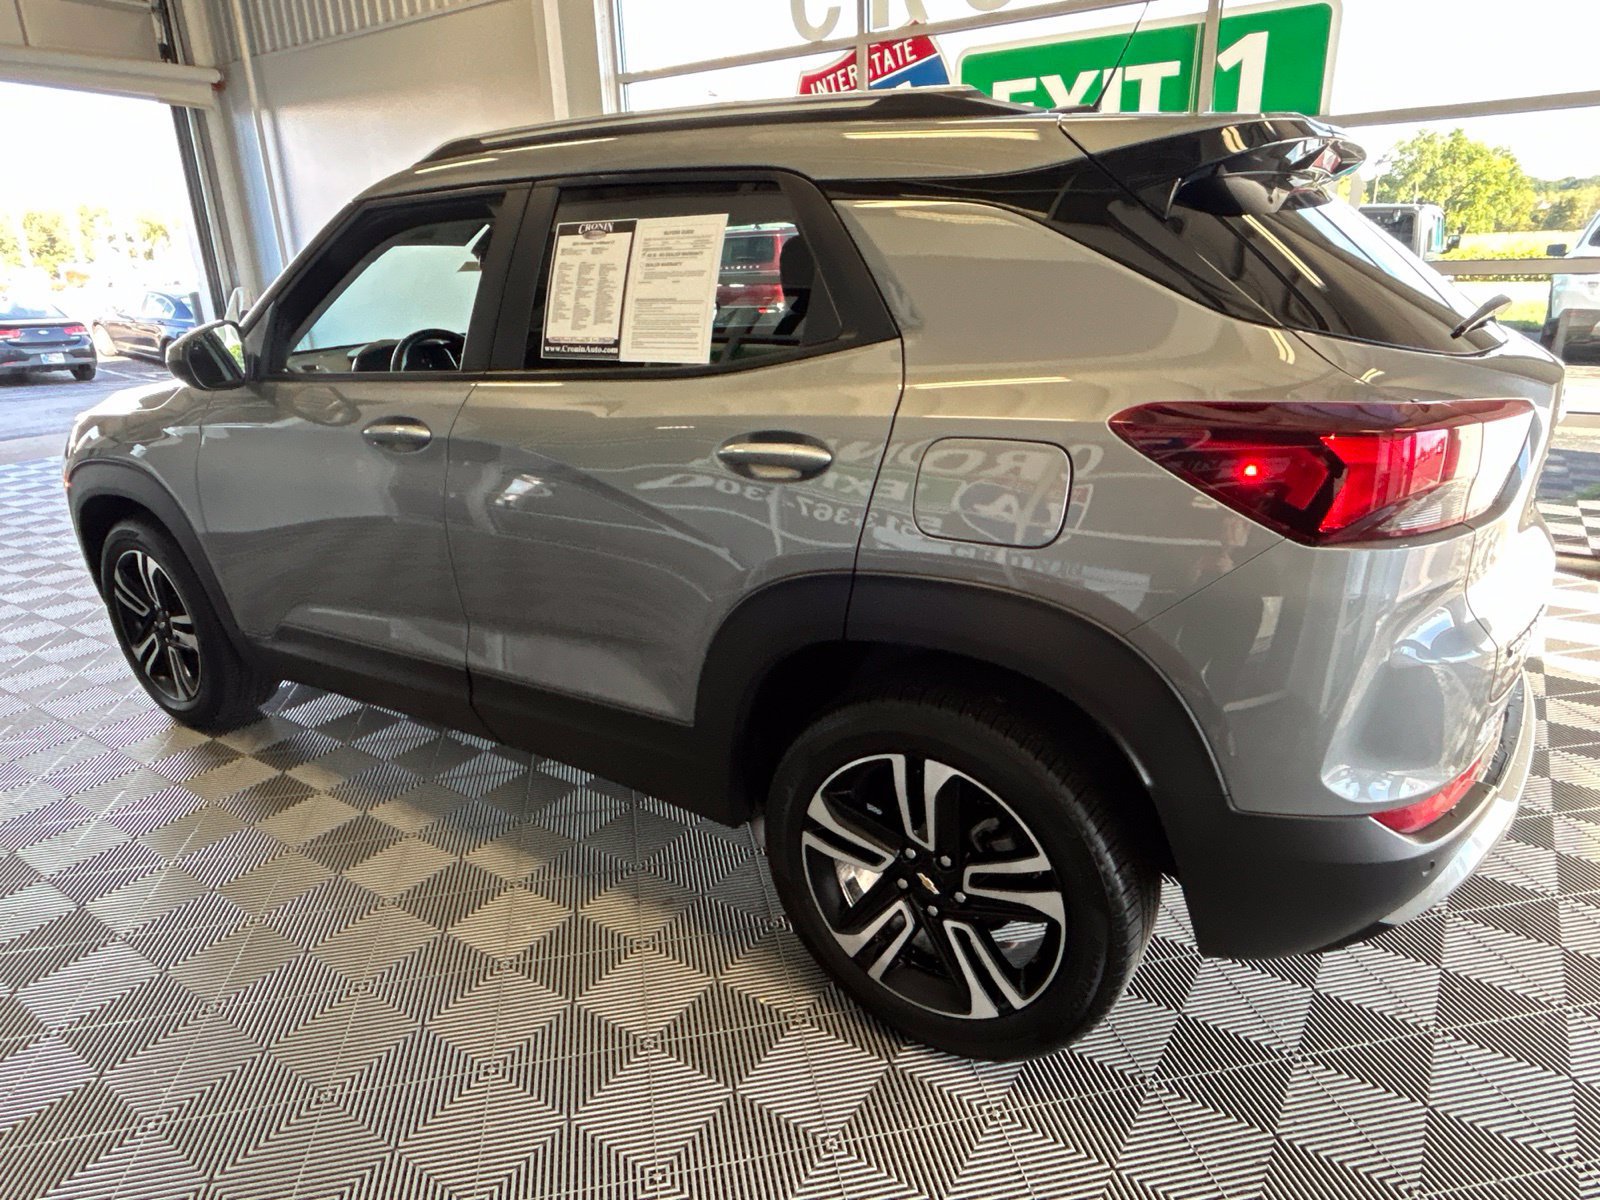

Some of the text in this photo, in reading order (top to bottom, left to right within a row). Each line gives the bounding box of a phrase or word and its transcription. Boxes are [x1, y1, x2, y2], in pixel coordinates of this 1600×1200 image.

[809, 38, 917, 95] INTERTATE
[992, 31, 1269, 113] EXIT 1
[577, 222, 614, 234] CRONIN
[544, 345, 618, 353] www.CroninAuto.com
